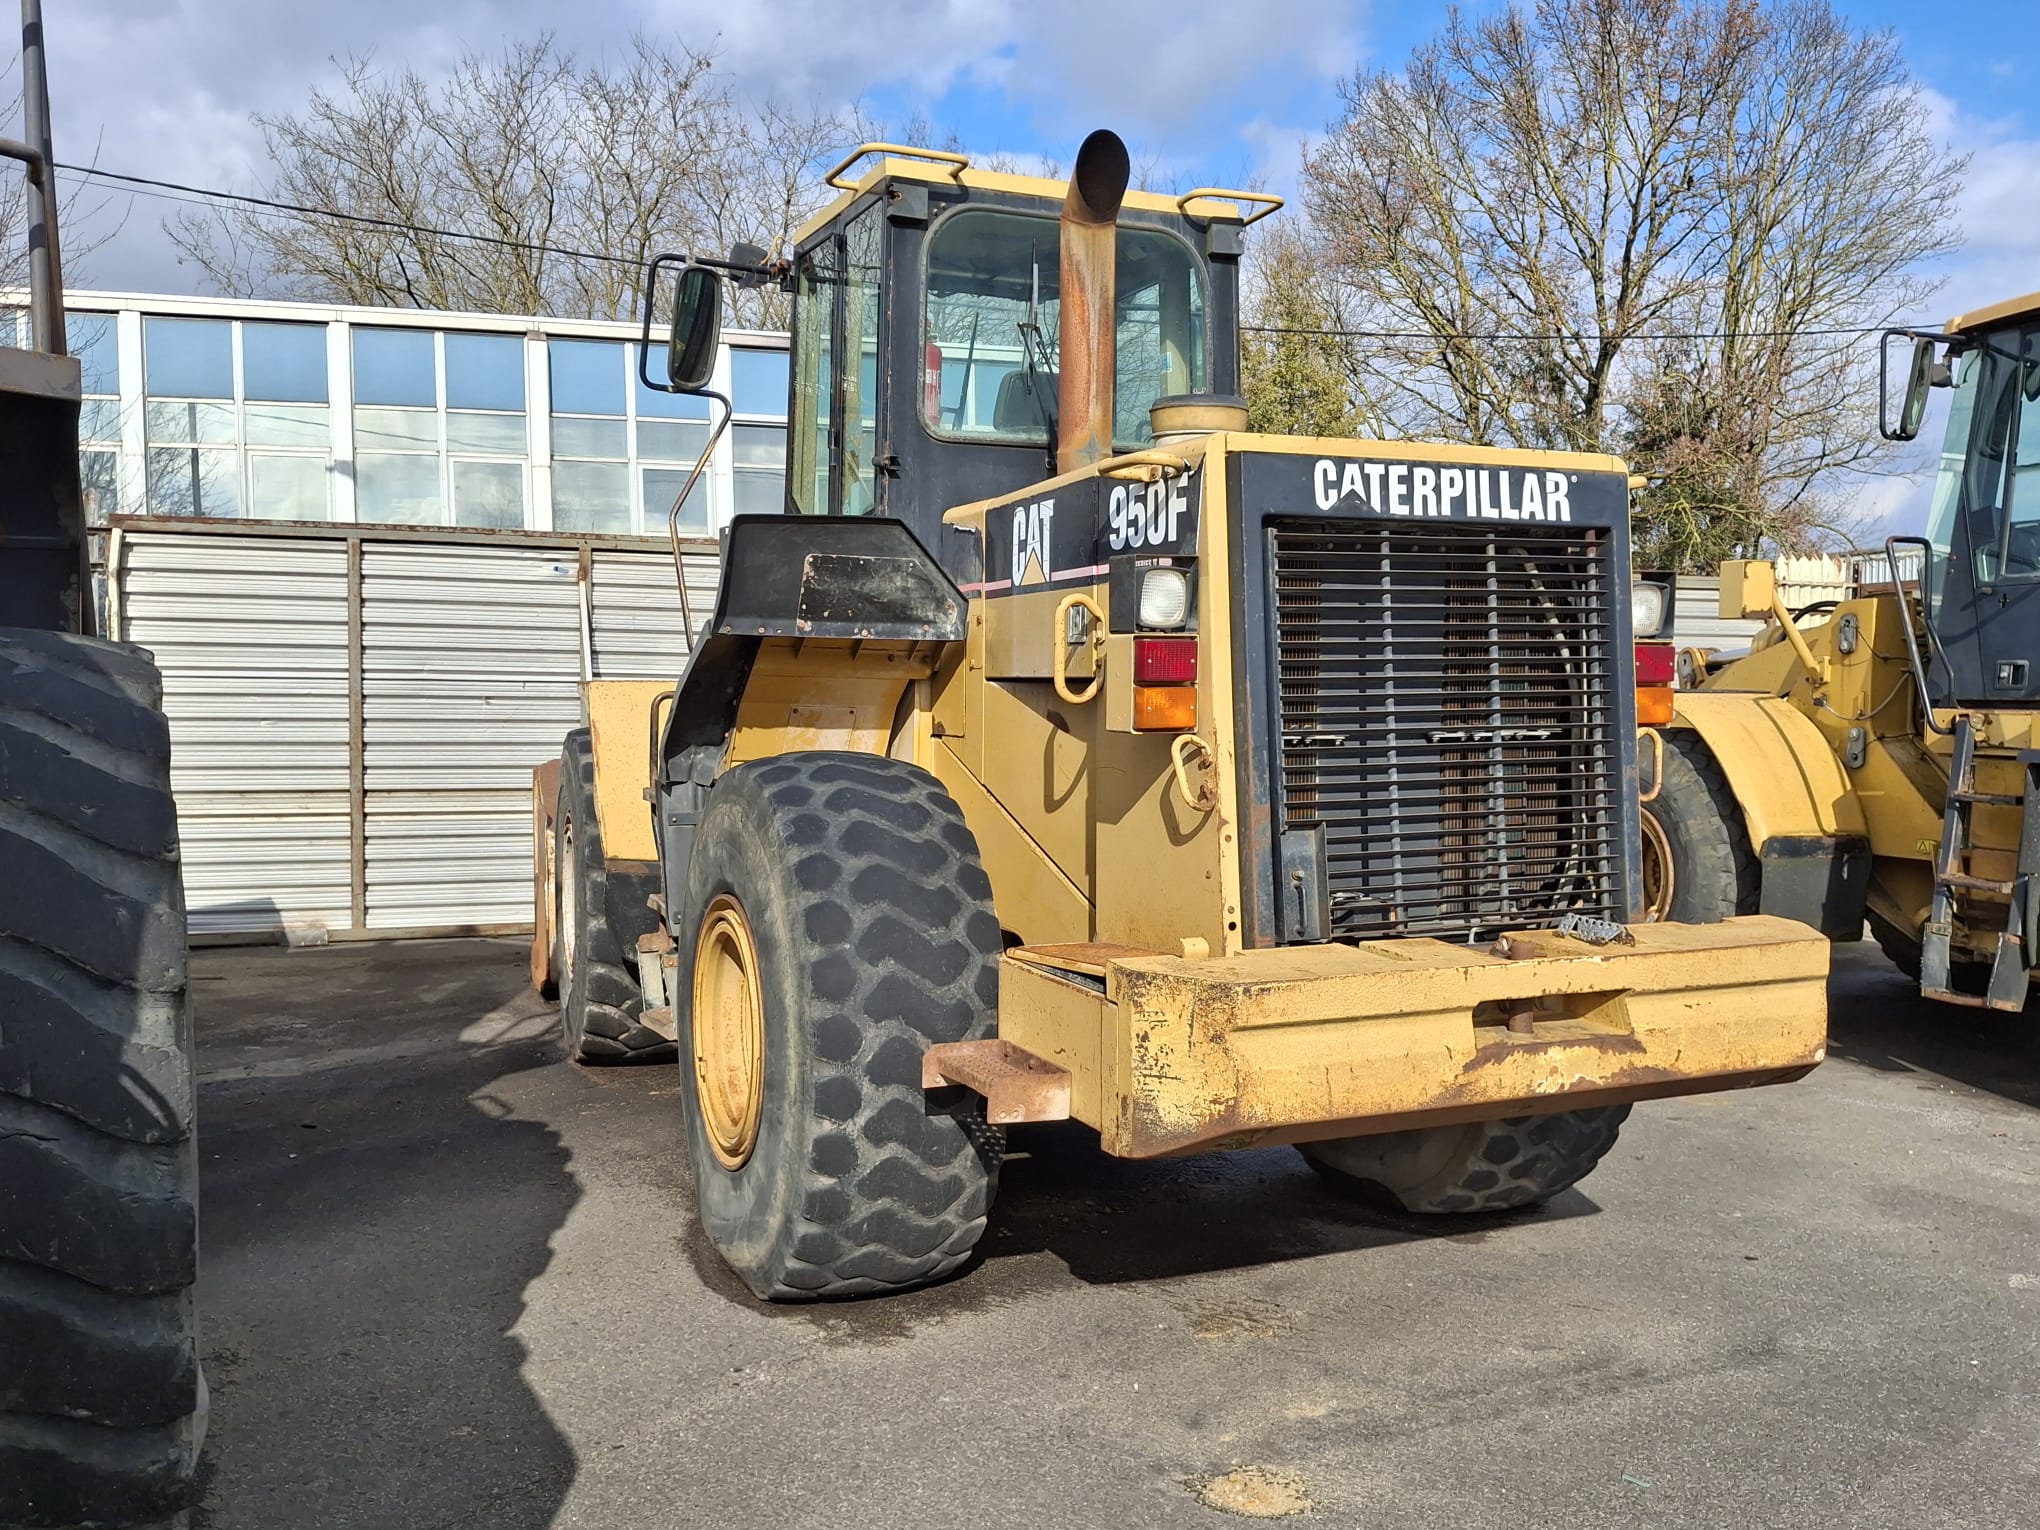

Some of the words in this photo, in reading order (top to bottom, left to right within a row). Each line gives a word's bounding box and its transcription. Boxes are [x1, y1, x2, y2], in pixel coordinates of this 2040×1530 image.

[1109, 472, 1188, 550] 950F
[1313, 459, 1572, 522] CATERPILLAR
[1012, 499, 1055, 587] CAT
